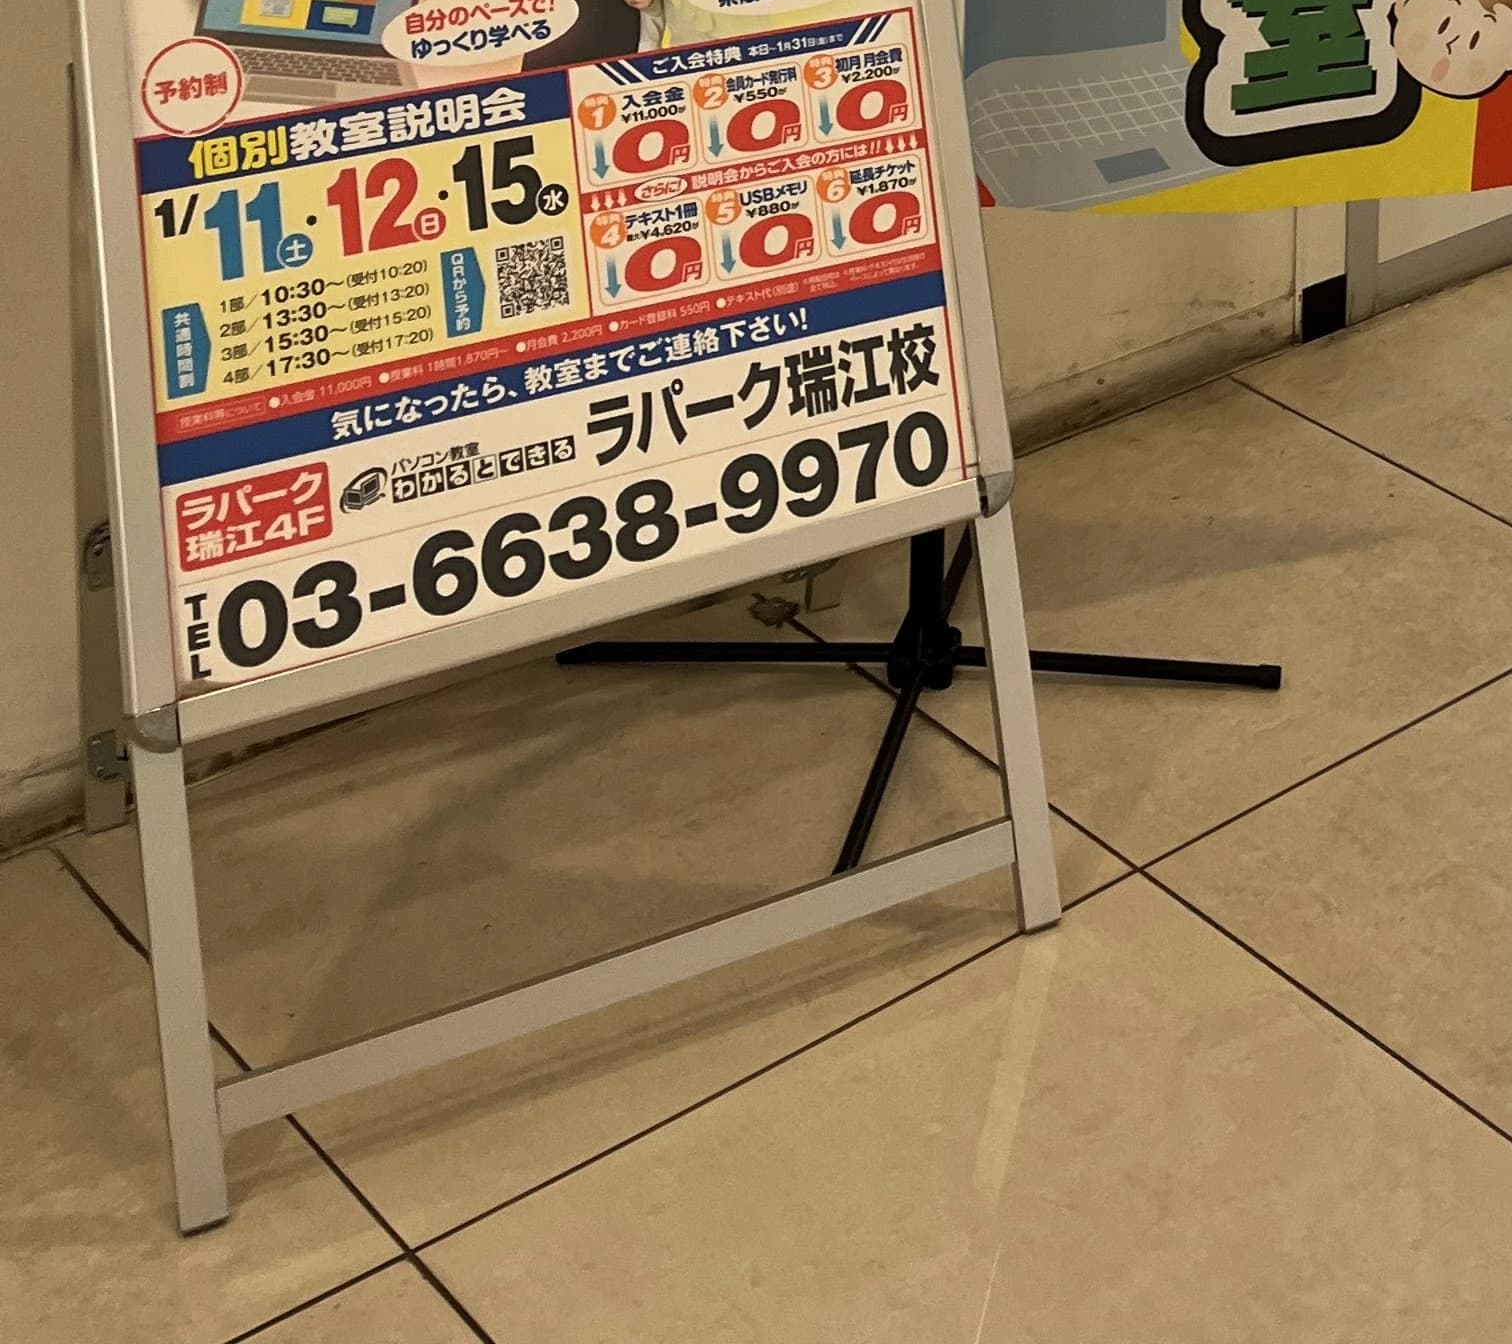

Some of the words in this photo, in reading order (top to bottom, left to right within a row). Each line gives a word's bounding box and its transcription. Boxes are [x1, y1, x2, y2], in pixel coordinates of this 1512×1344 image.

[411, 19, 551, 59] ゆっくり学べる
[652, 46, 742, 74] ご入会特典
[154, 71, 228, 104] 予約制
[621, 86, 686, 111] 入会金
[188, 87, 527, 180] 個別教室説明会
[587, 322, 941, 466] ラパーク瑞江校
[391, 442, 480, 477] パソコン教室
[391, 435, 577, 504] わかるとできる
[181, 470, 324, 531] ラパーク
[184, 593, 212, 680] TEL
[217, 410, 949, 668] 03-6638-9970
[186, 506, 326, 563] 瑞江4F
